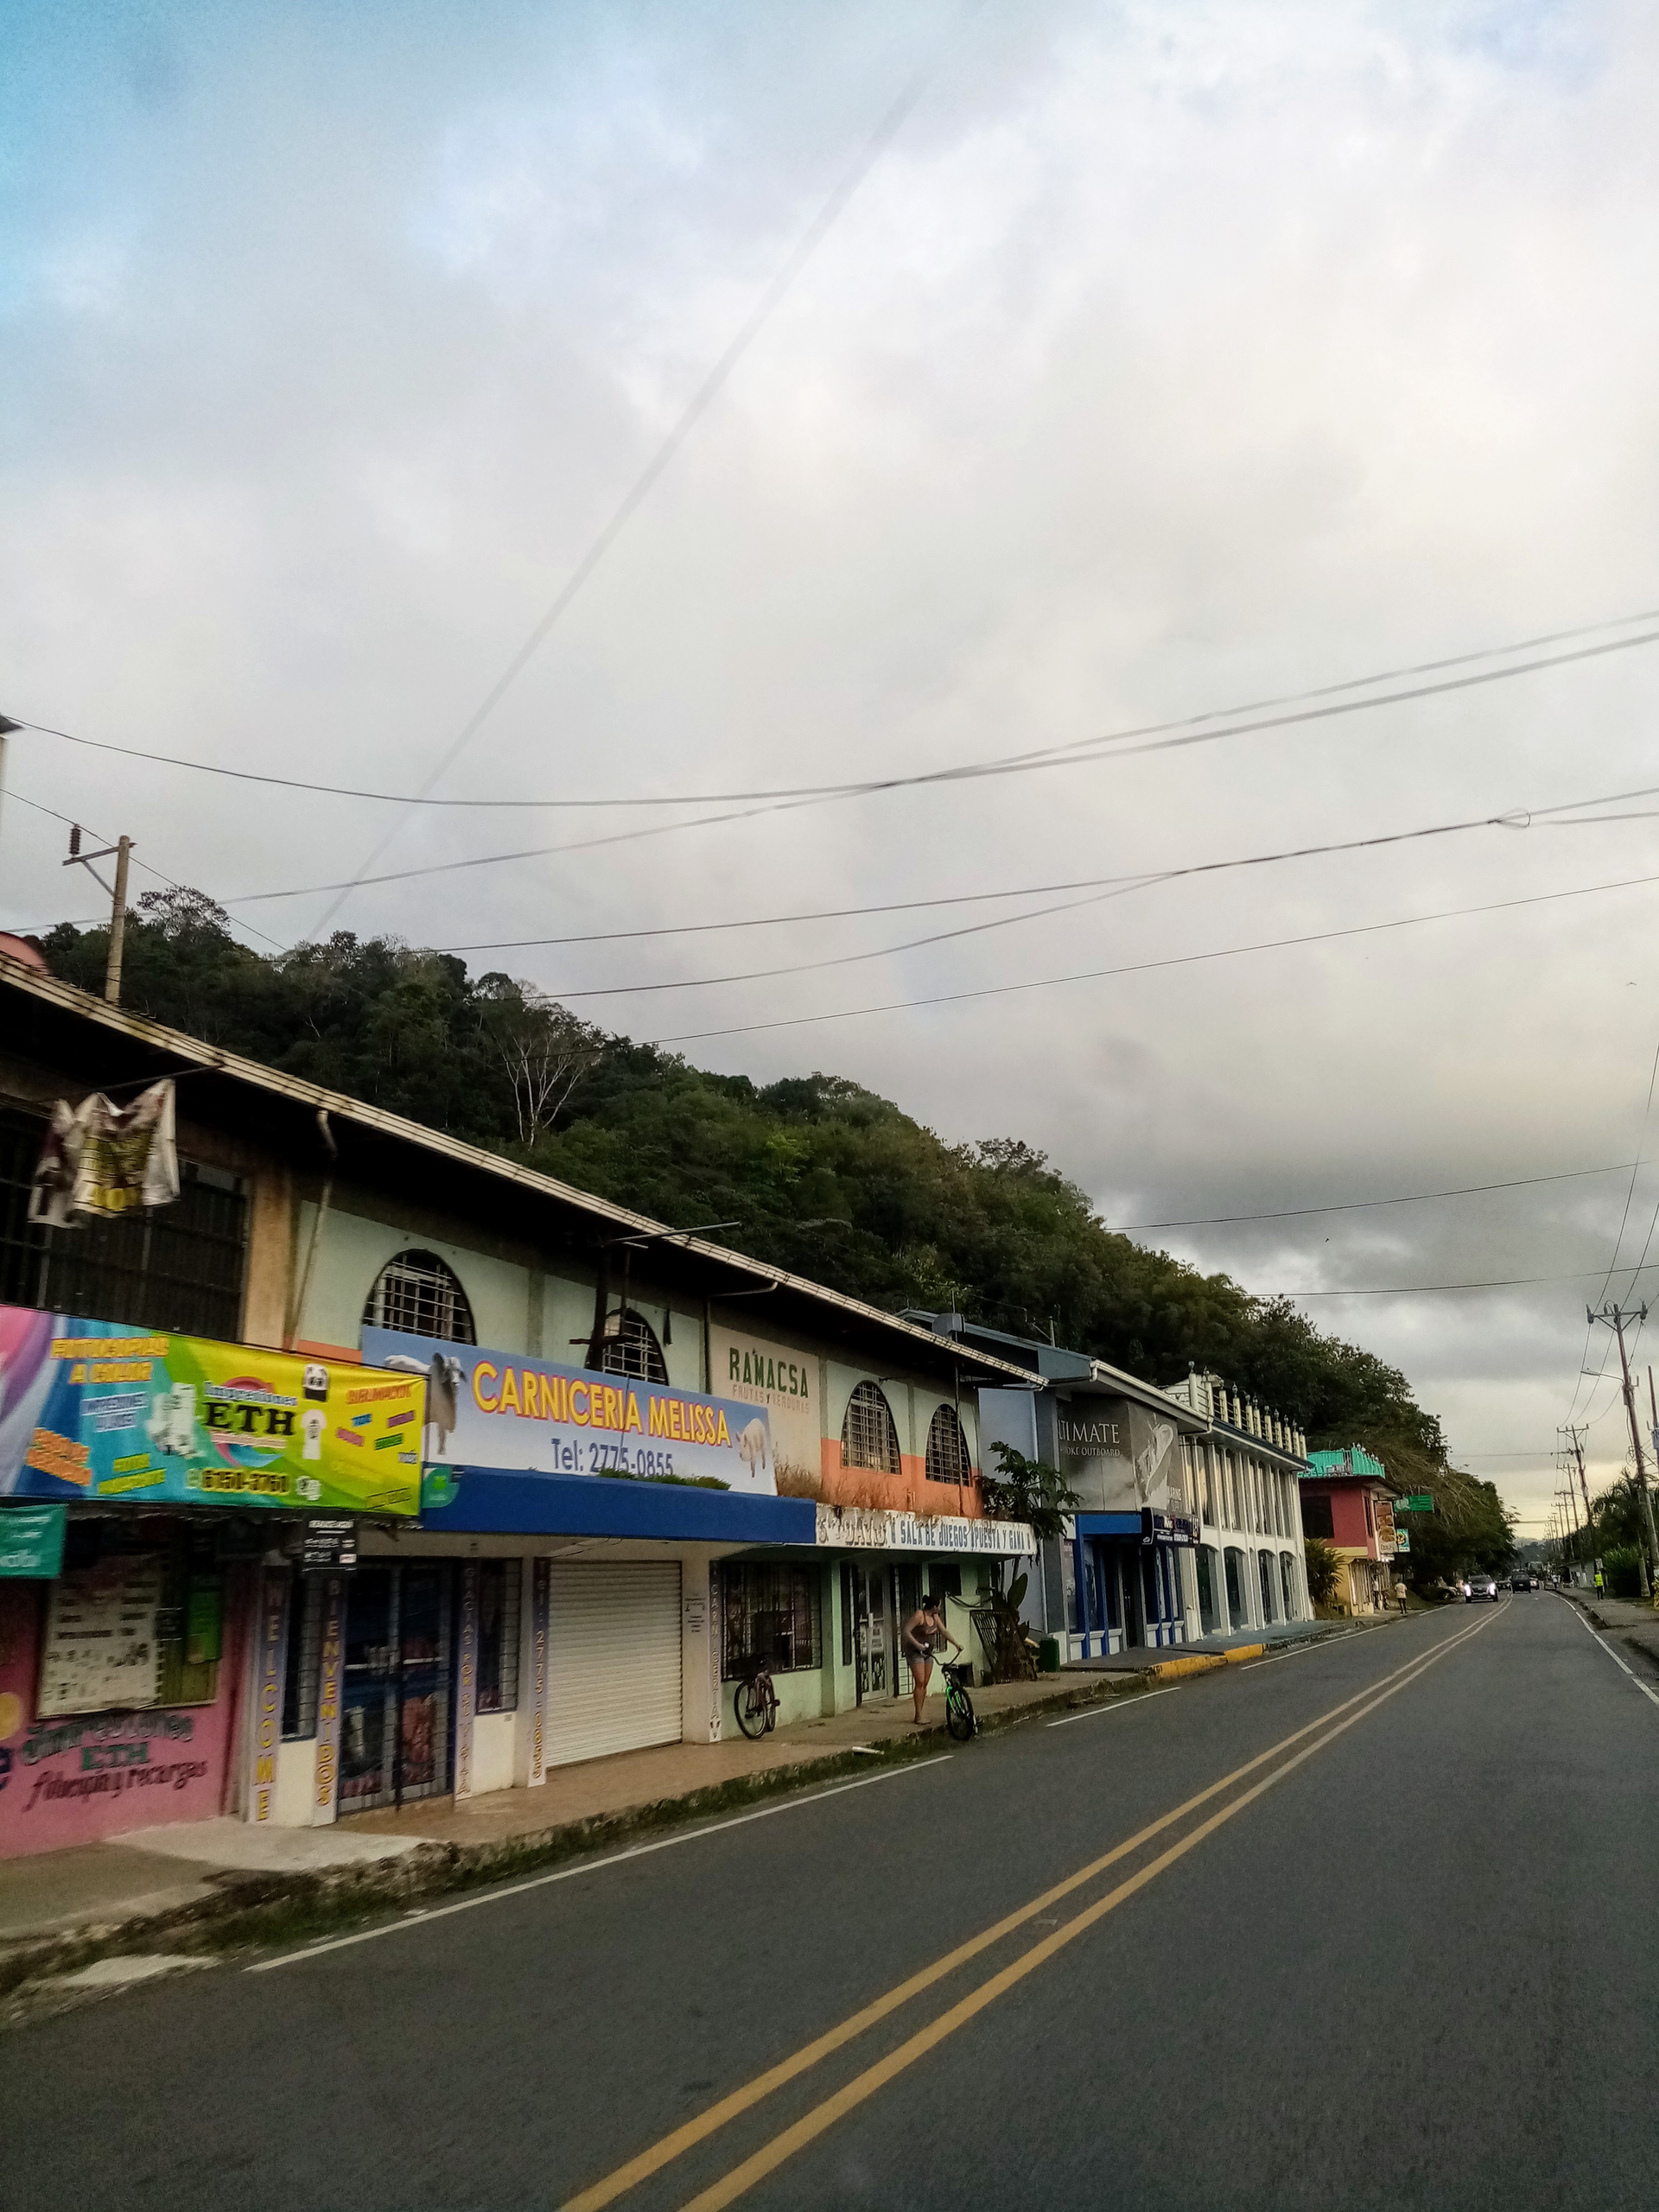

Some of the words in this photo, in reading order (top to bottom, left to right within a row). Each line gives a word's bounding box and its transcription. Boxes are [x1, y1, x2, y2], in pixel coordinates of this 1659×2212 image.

[729, 1347, 809, 1398] RAMACSA
[201, 1402, 296, 1435] ETH
[473, 1361, 643, 1435] CARNICERIA
[649, 1395, 733, 1449] MELISSA
[550, 1438, 583, 1471] Tel:
[588, 1441, 674, 1478] 2775-0855
[900, 1520, 923, 1546] SALA
[939, 1523, 968, 1548] JUEGOS
[81, 1742, 149, 1770] ETH
